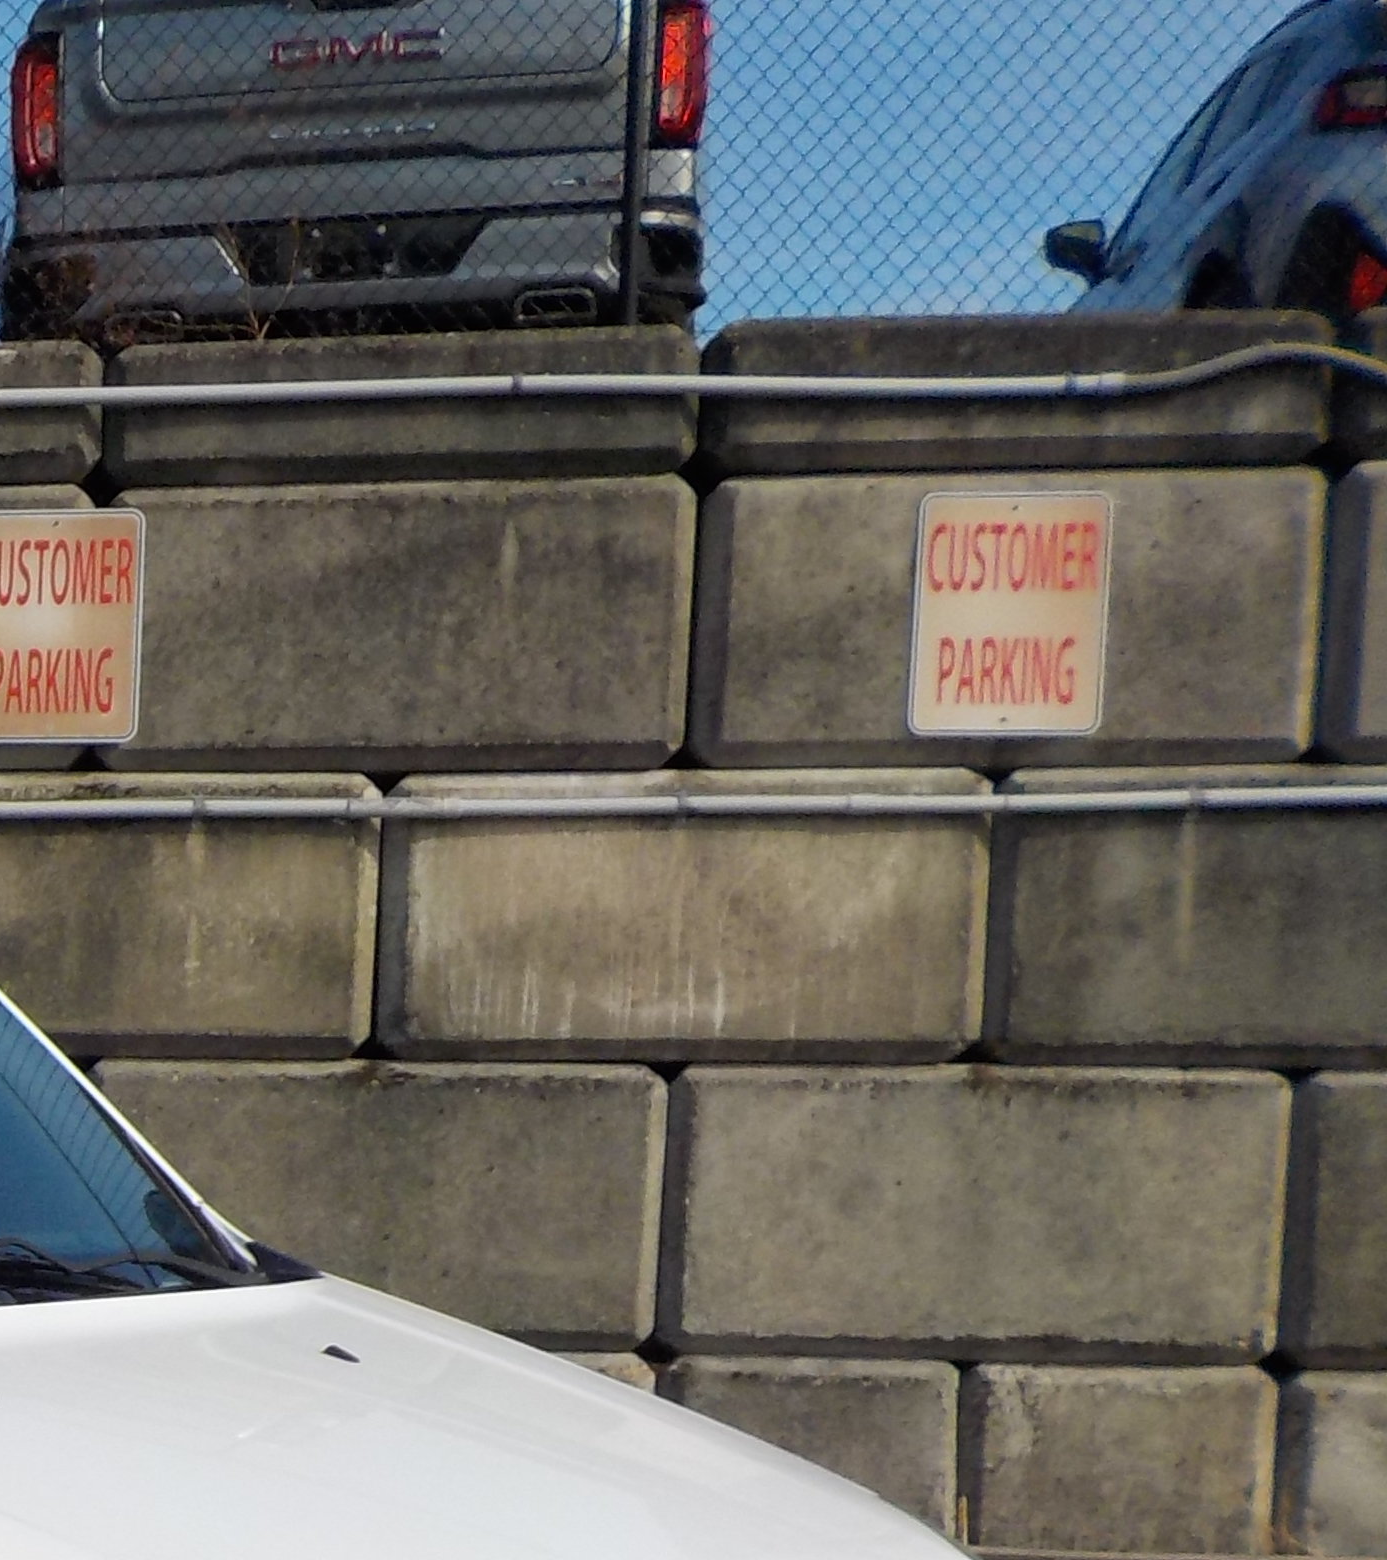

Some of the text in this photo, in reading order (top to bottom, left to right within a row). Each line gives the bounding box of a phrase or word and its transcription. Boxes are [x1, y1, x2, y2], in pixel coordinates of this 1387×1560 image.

[269, 27, 446, 70] GMC
[928, 522, 1099, 592] CUSTOMER
[935, 636, 1076, 705] PARKING
